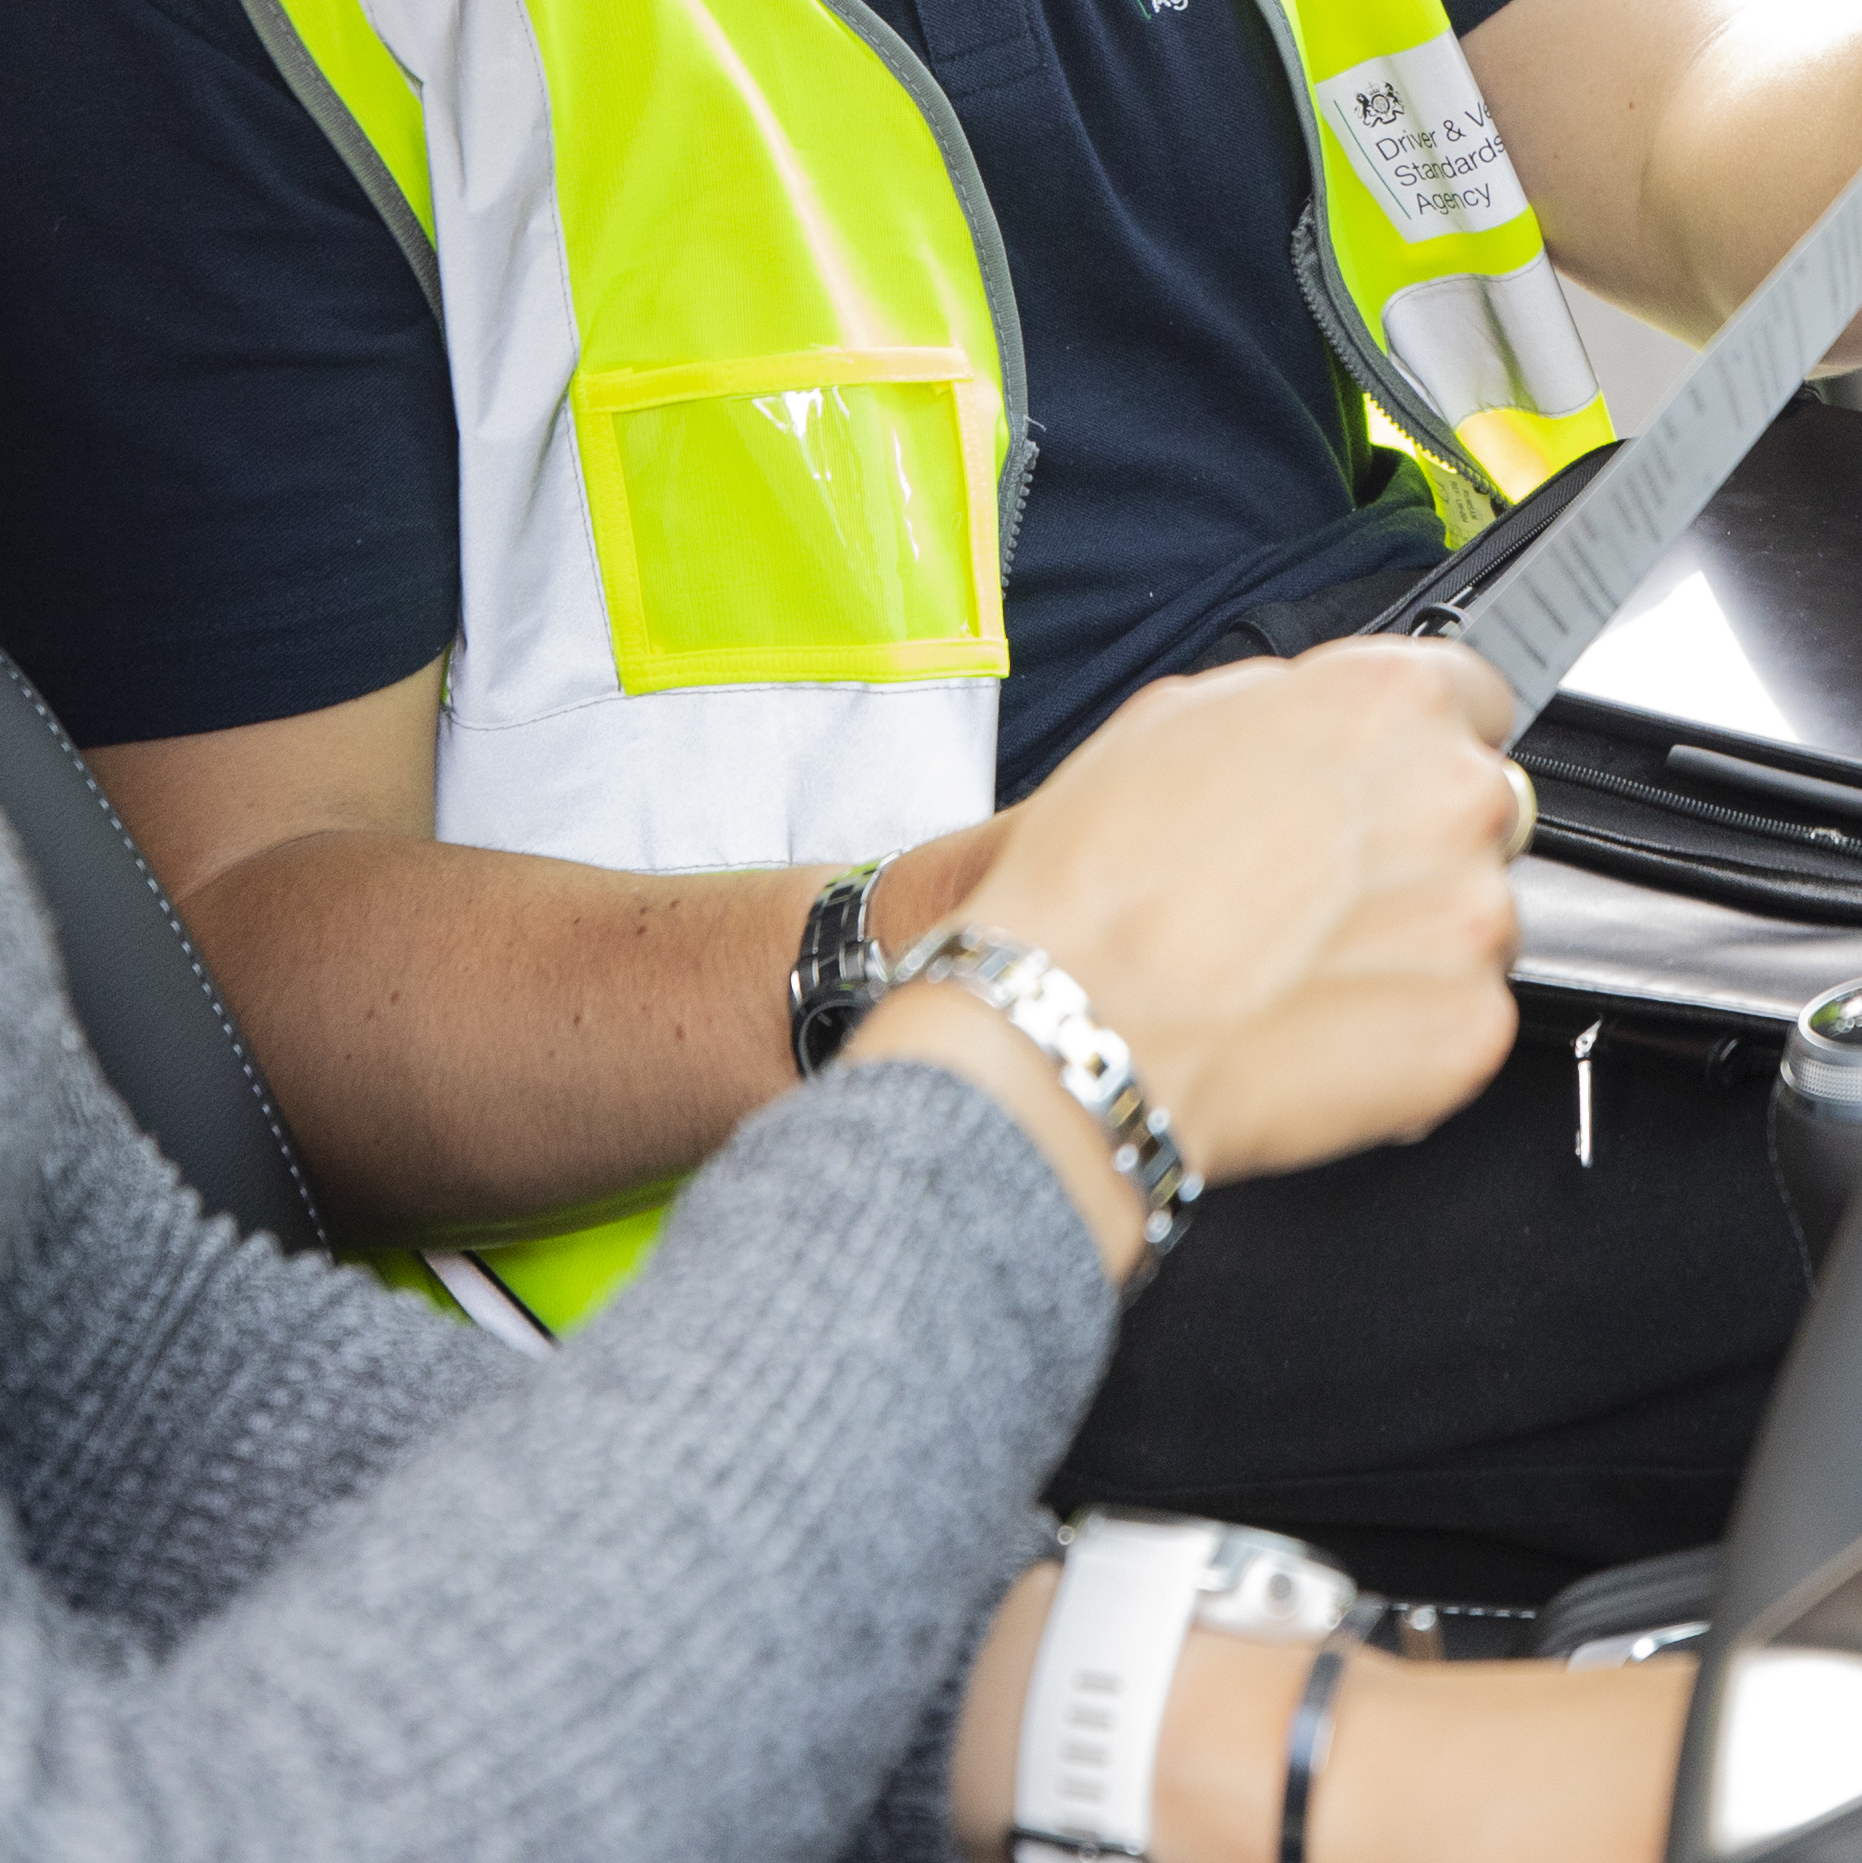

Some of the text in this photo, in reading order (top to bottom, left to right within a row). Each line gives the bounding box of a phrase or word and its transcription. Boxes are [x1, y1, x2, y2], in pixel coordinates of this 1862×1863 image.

[1375, 129, 1439, 162] Driver
[1443, 119, 1467, 143] &
[1394, 134, 1506, 187] Standards
[1416, 183, 1491, 216] Agency
